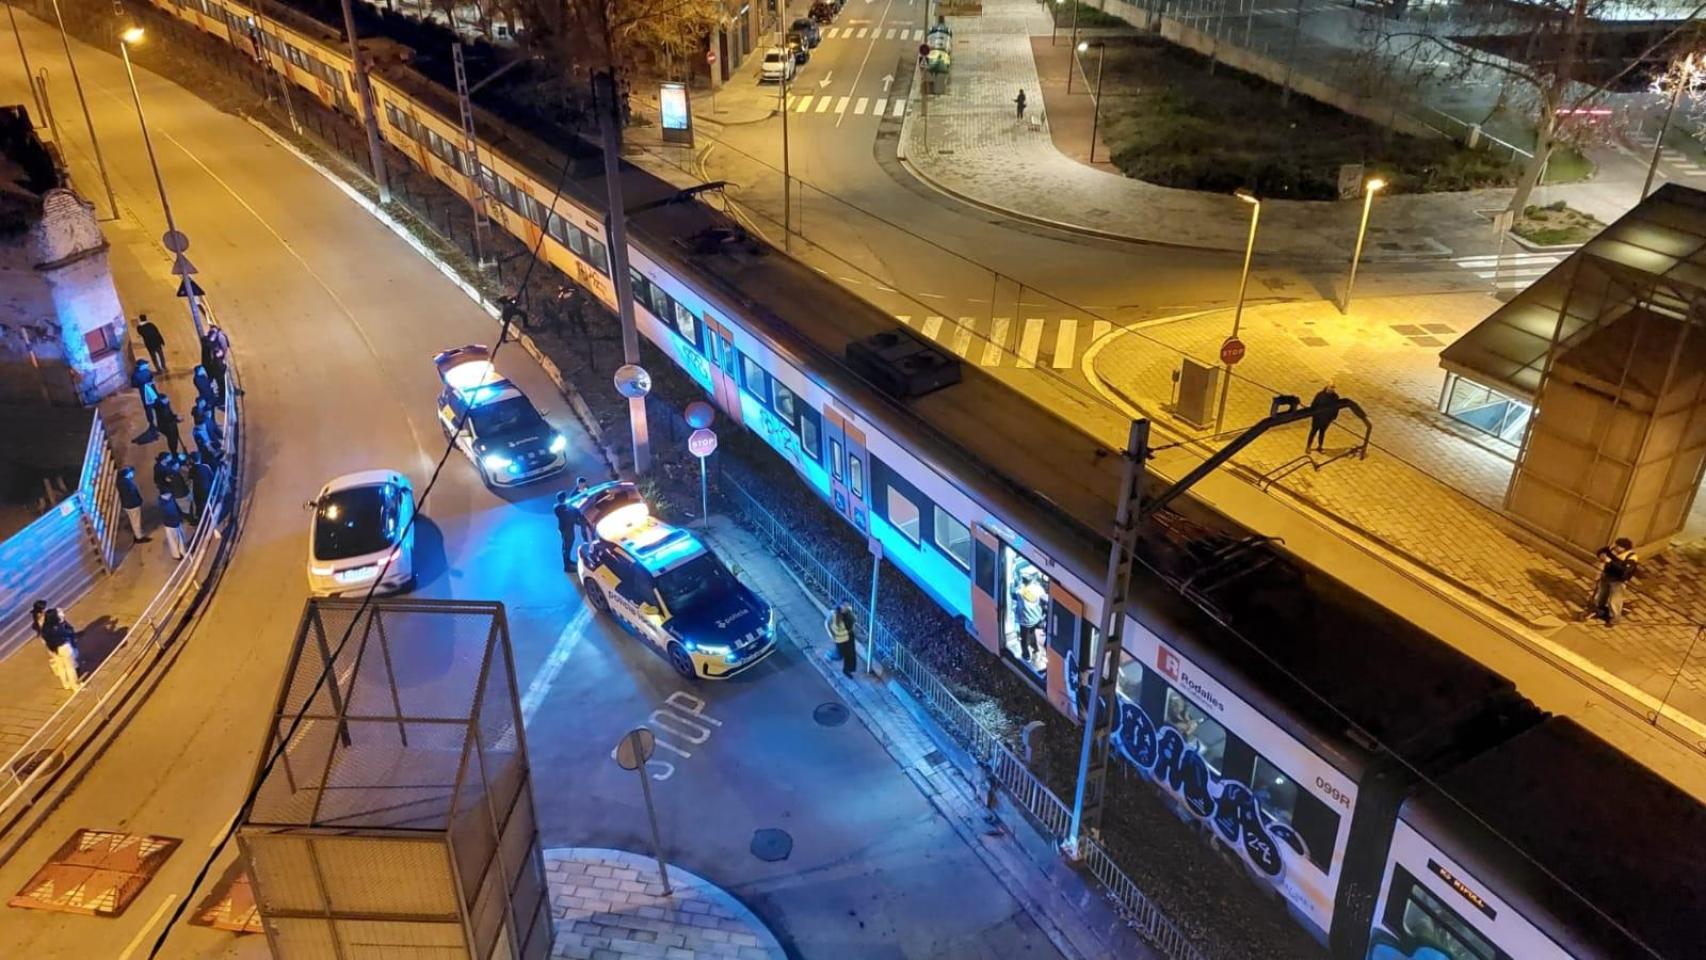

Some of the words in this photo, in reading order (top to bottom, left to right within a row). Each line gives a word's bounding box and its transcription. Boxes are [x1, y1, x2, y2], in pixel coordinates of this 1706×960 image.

[1222, 348, 1244, 357] STOP
[691, 438, 715, 449] STOP
[1165, 653, 1179, 677] R
[1181, 672, 1225, 712] Rodalies
[1315, 775, 1351, 809] 099R
